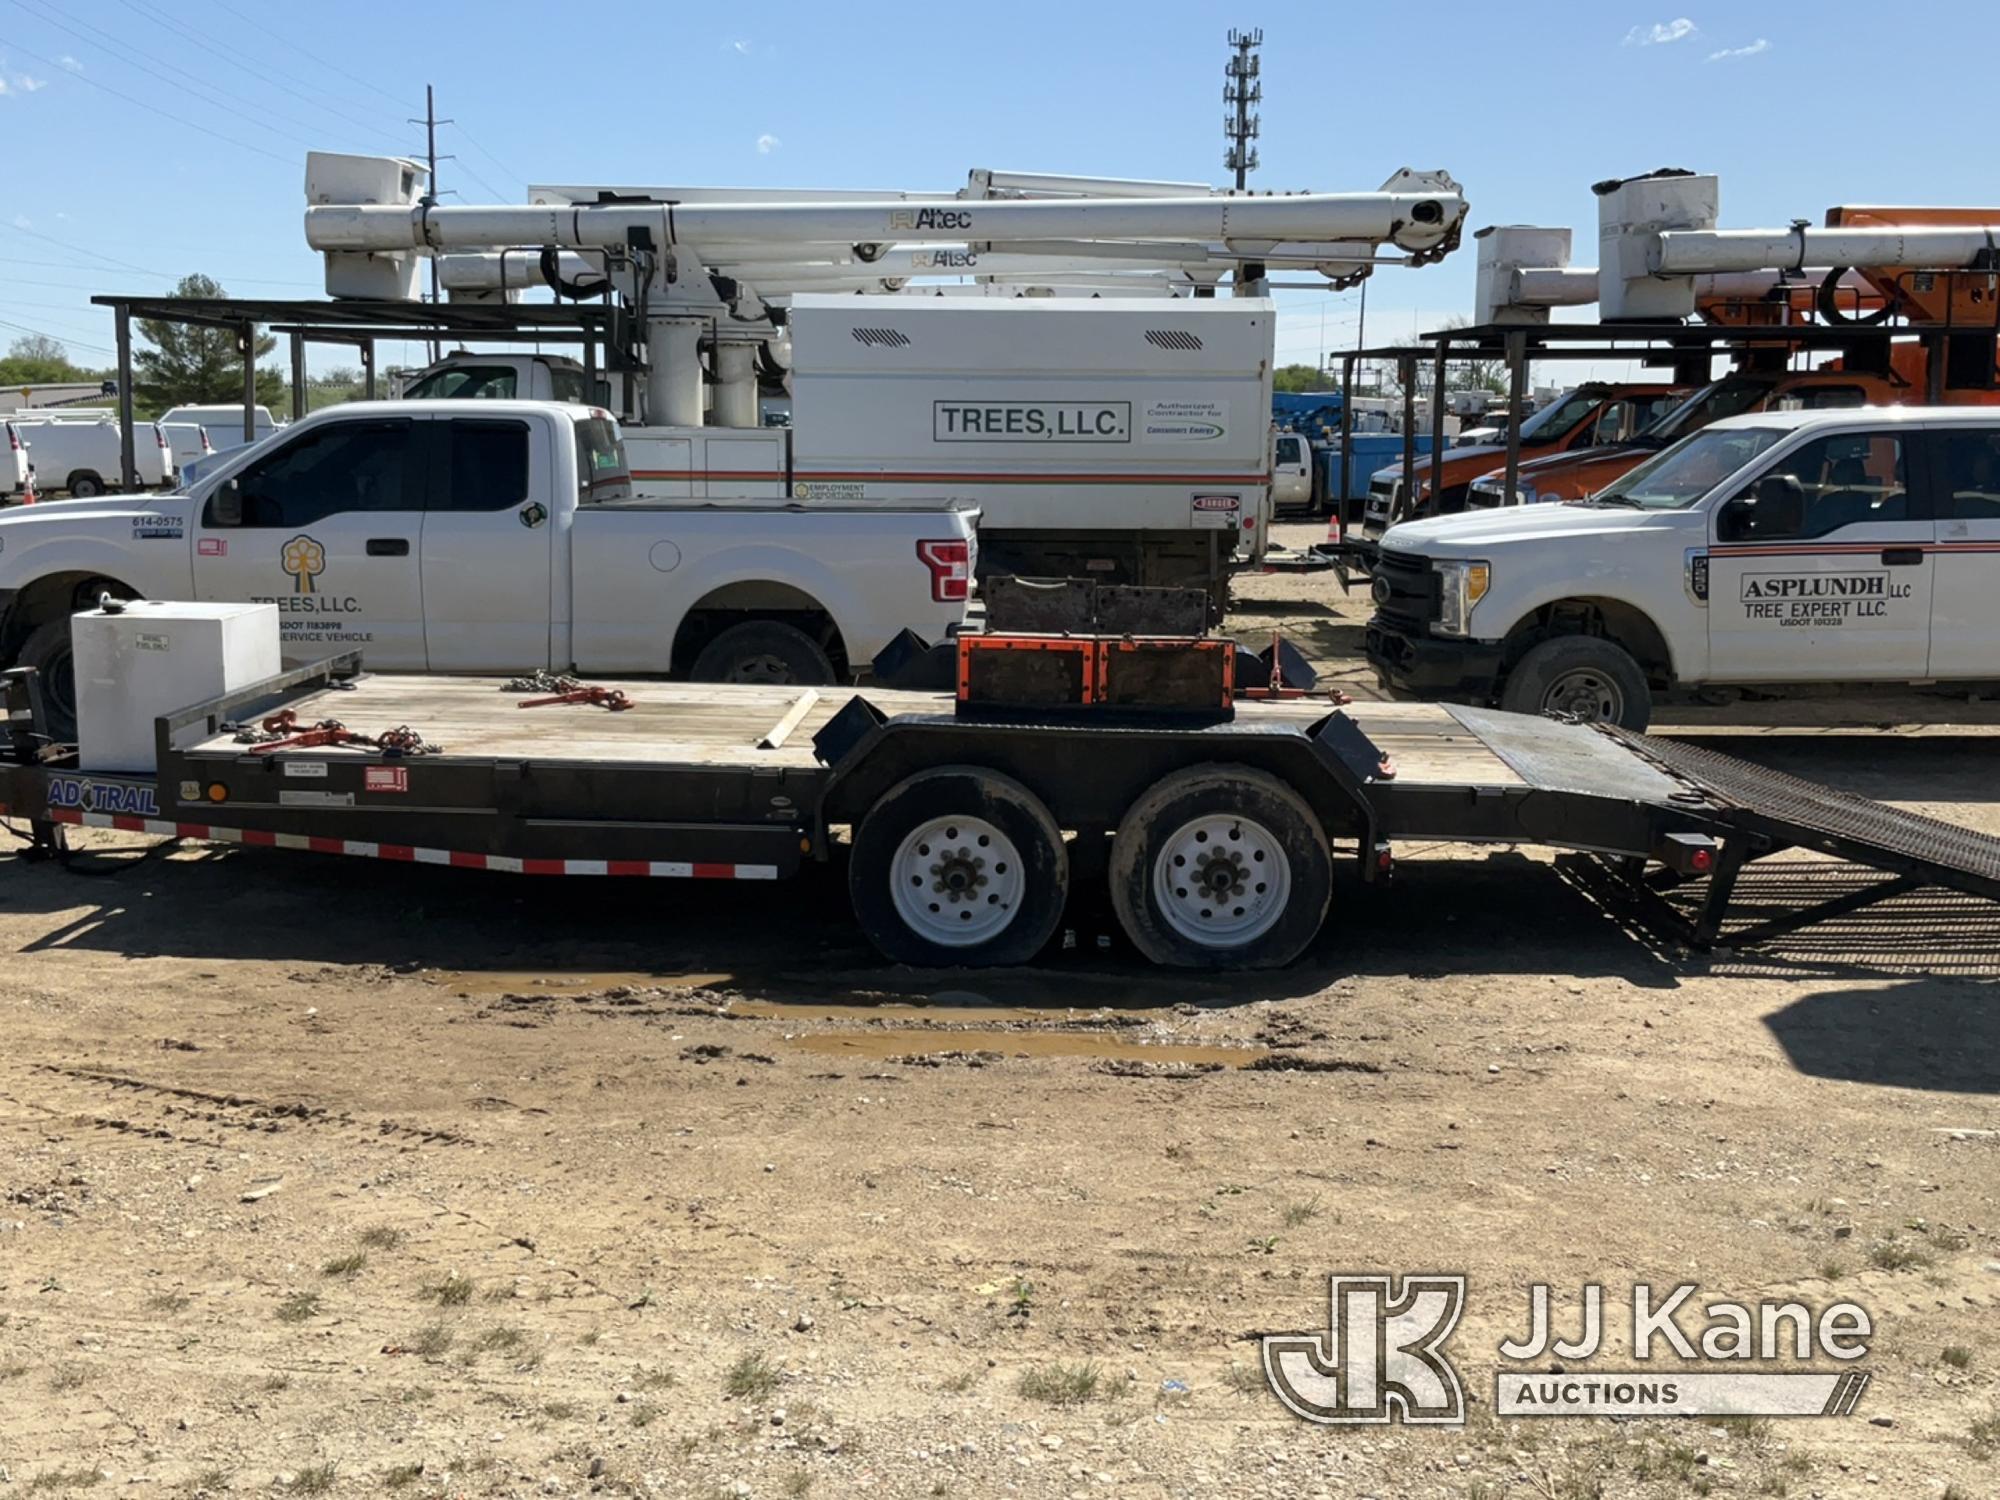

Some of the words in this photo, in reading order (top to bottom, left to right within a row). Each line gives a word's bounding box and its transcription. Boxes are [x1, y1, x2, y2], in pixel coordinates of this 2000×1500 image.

[915, 207, 972, 230] Altec
[932, 250, 977, 268] Altec
[1147, 409, 1203, 417] Contractor
[1207, 409, 1222, 417] for
[941, 408, 1125, 439] TREES,LLC.
[1146, 426, 1187, 434] Consumers
[1189, 426, 1215, 436] Energy
[132, 516, 183, 526] 614-0575
[1744, 577, 1884, 598] ASPLUNDH
[1890, 583, 1912, 598] LLC
[1744, 603, 1784, 618] TREE
[1791, 602, 1851, 617] EXPERT
[1857, 601, 1888, 616] LLC.
[280, 621, 304, 630] SDOT
[1780, 618, 1811, 627] USDOT
[1813, 617, 1843, 626] 101328
[326, 632, 373, 641] VEHICLE
[92, 784, 160, 815] TRAIL
